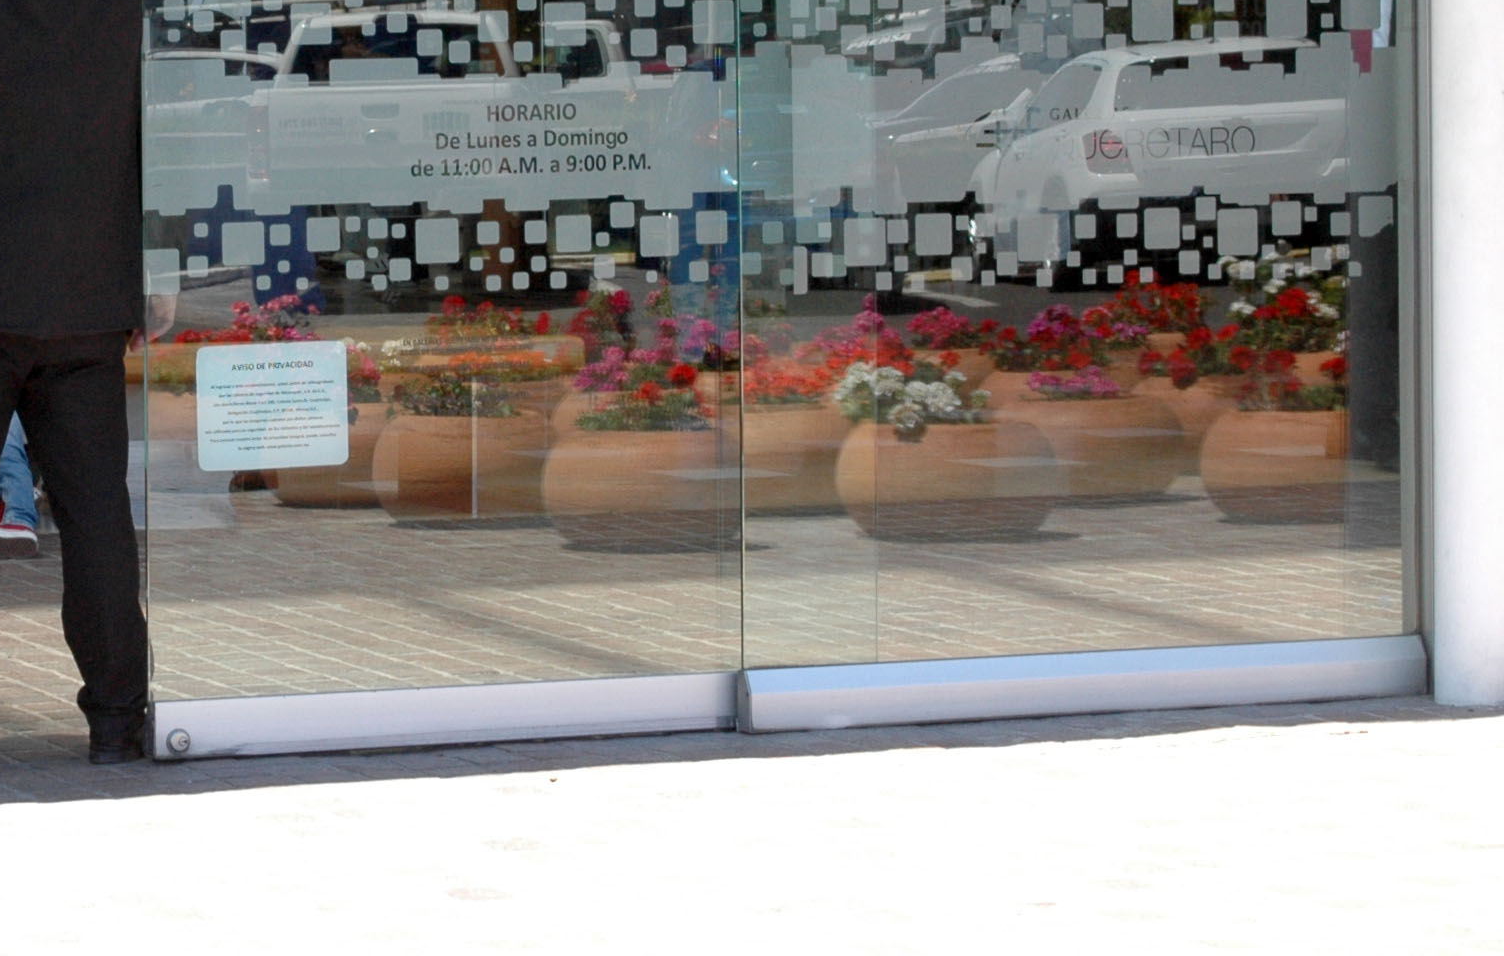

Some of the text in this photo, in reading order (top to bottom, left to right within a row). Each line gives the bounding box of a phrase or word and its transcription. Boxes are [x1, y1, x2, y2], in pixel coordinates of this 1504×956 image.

[486, 102, 577, 123] HORARIO
[435, 128, 629, 150] De Lunes a Domingo
[410, 153, 651, 177] de 11:00 A.M. a 9:00 P.M.
[268, 360, 314, 369] PRIVACIDAD
